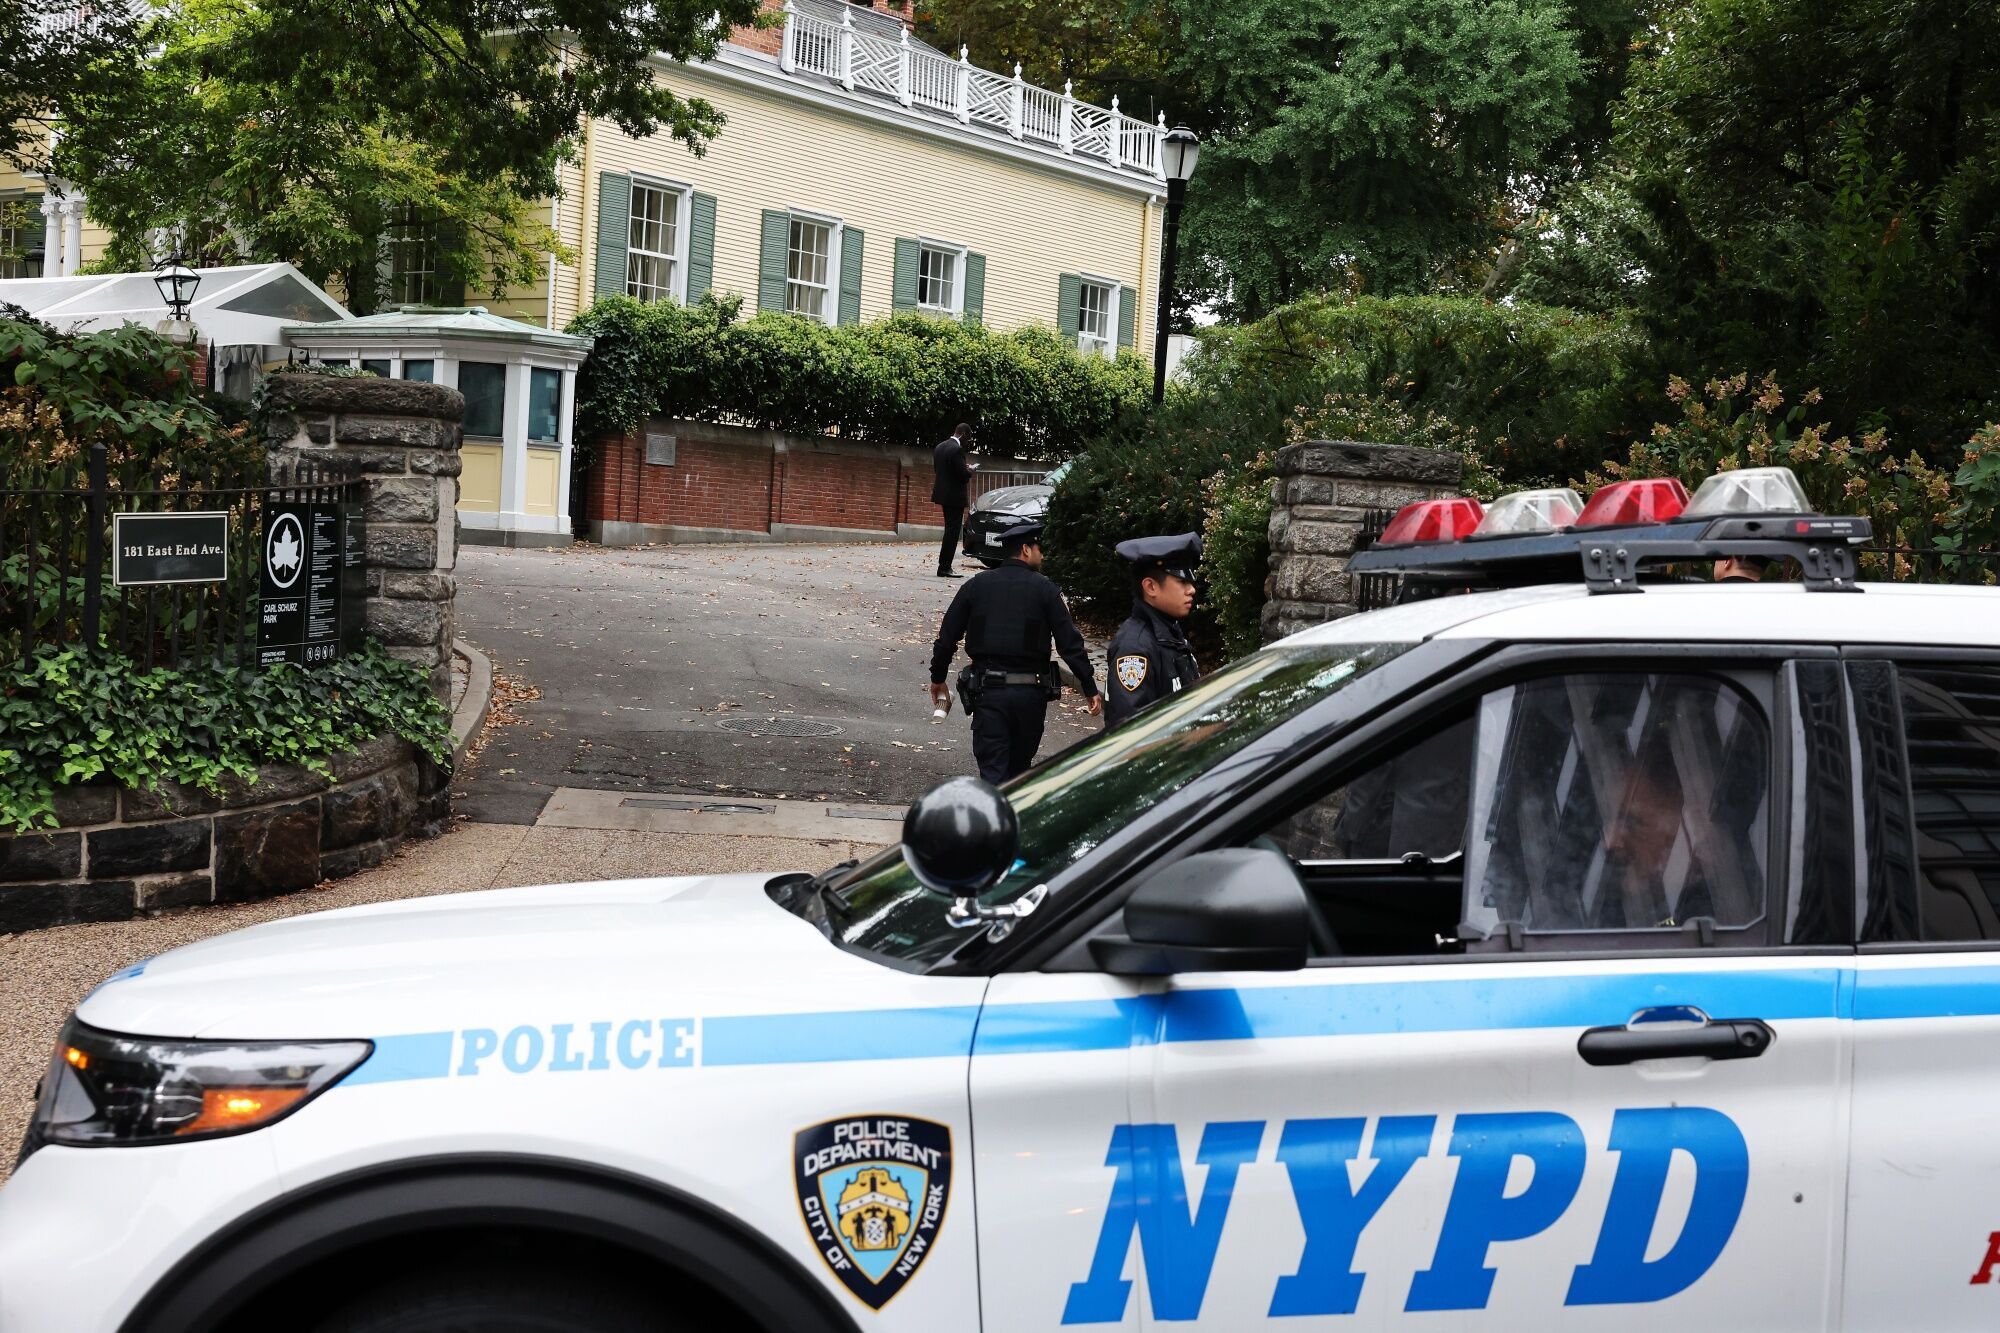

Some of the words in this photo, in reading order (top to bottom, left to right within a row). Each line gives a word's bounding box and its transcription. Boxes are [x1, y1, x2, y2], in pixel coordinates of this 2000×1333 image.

[124, 546, 143, 557] 181
[147, 545, 172, 556] East
[175, 544, 197, 555] End
[200, 544, 224, 554] Ave.
[263, 614, 278, 624] PARK
[264, 603, 277, 613] CARL
[277, 602, 298, 612] SCHURZ
[457, 1017, 695, 1077] POLICE
[833, 1120, 910, 1143] POLICE
[804, 1140, 942, 1177] DEPARTMENT
[804, 1195, 833, 1241] CITY
[826, 1245, 852, 1271] OF
[896, 1236, 927, 1277] NEW
[920, 1183, 944, 1230] YORK
[1061, 1106, 1750, 1325] NYPD
